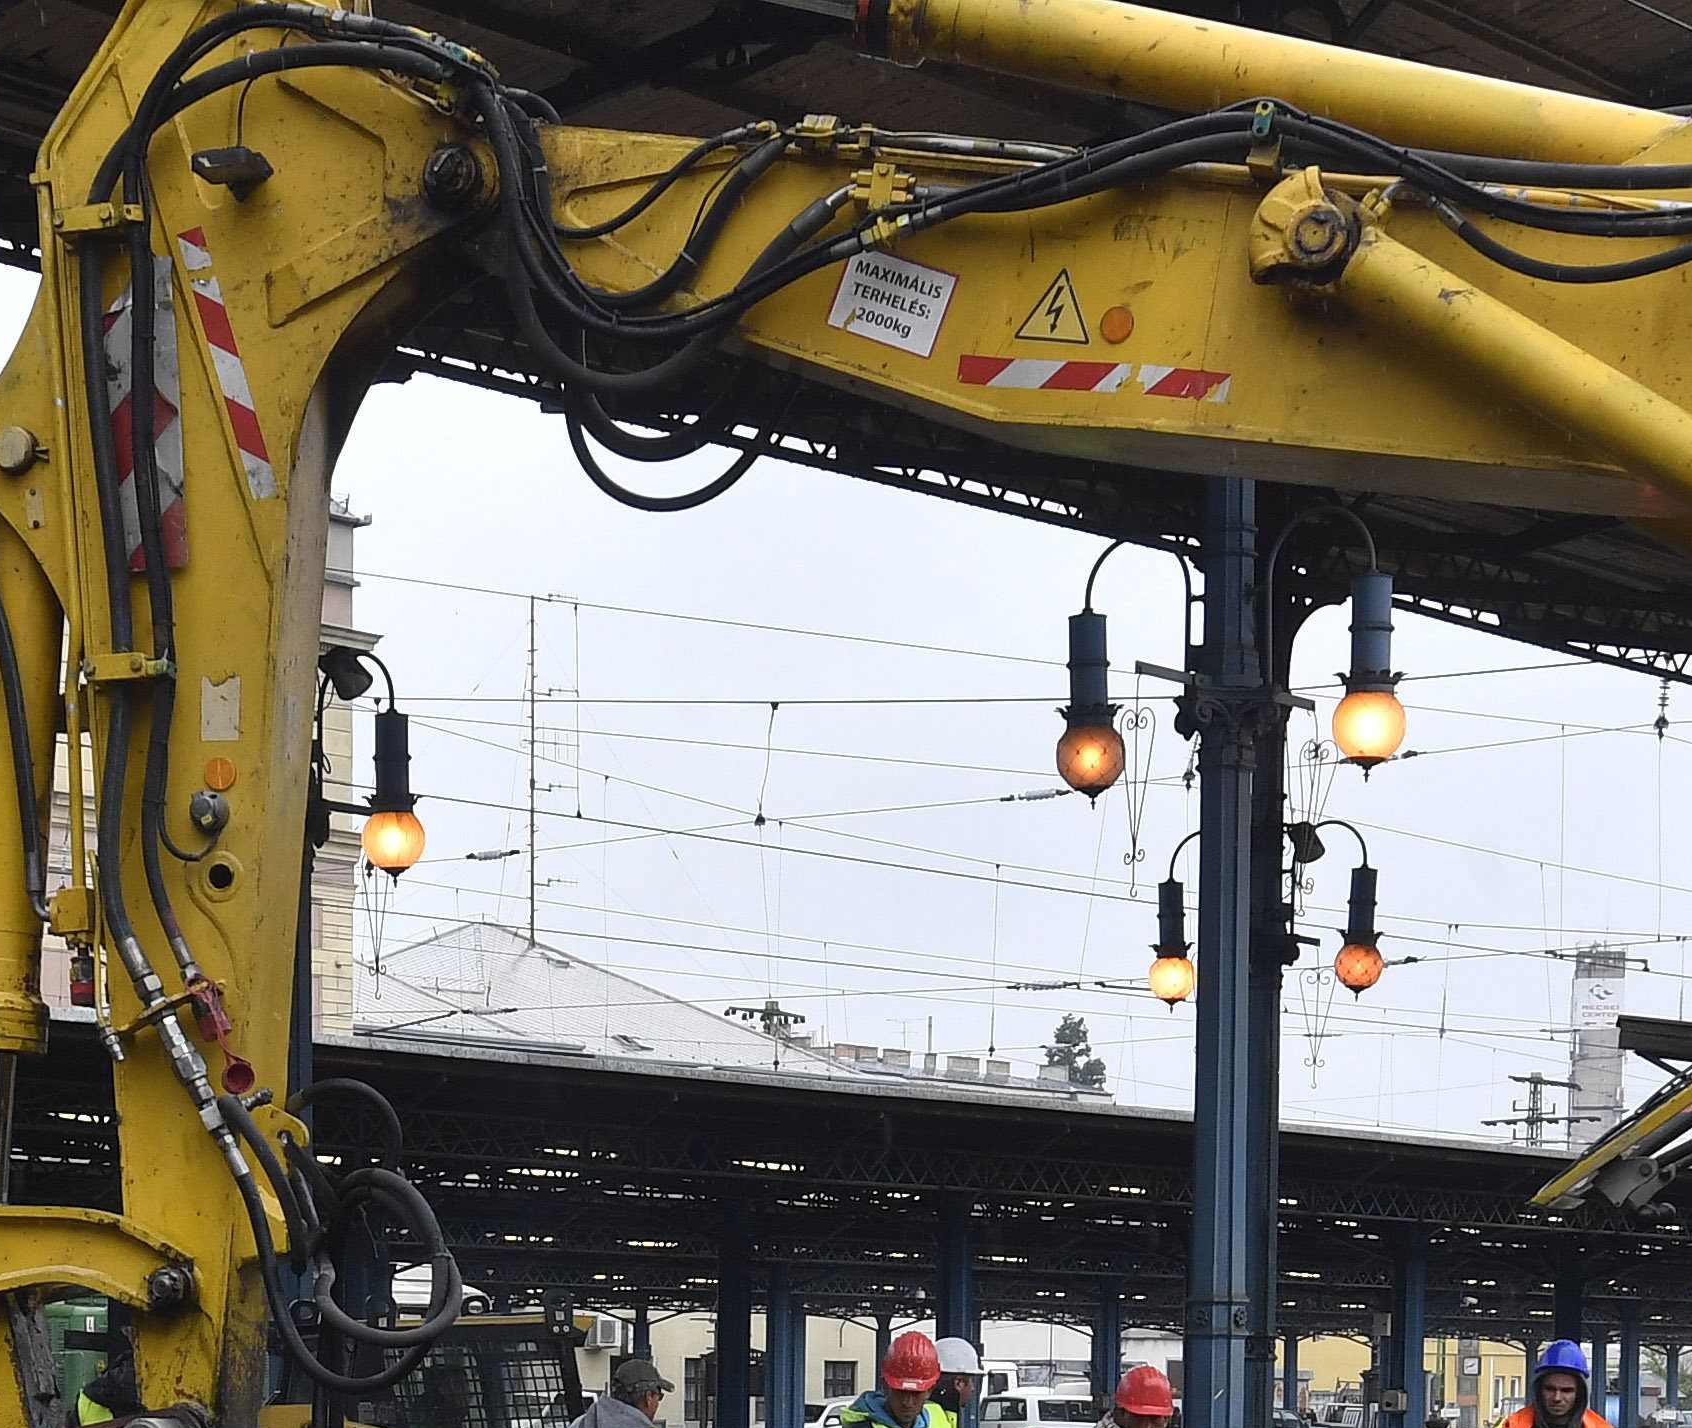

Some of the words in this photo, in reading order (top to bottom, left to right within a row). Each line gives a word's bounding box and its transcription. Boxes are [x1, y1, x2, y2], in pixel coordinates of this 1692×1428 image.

[855, 260, 943, 299] MAXIMÁLIS
[853, 282, 932, 319] TERHELÉS:
[856, 307, 912, 339] 2000kg
